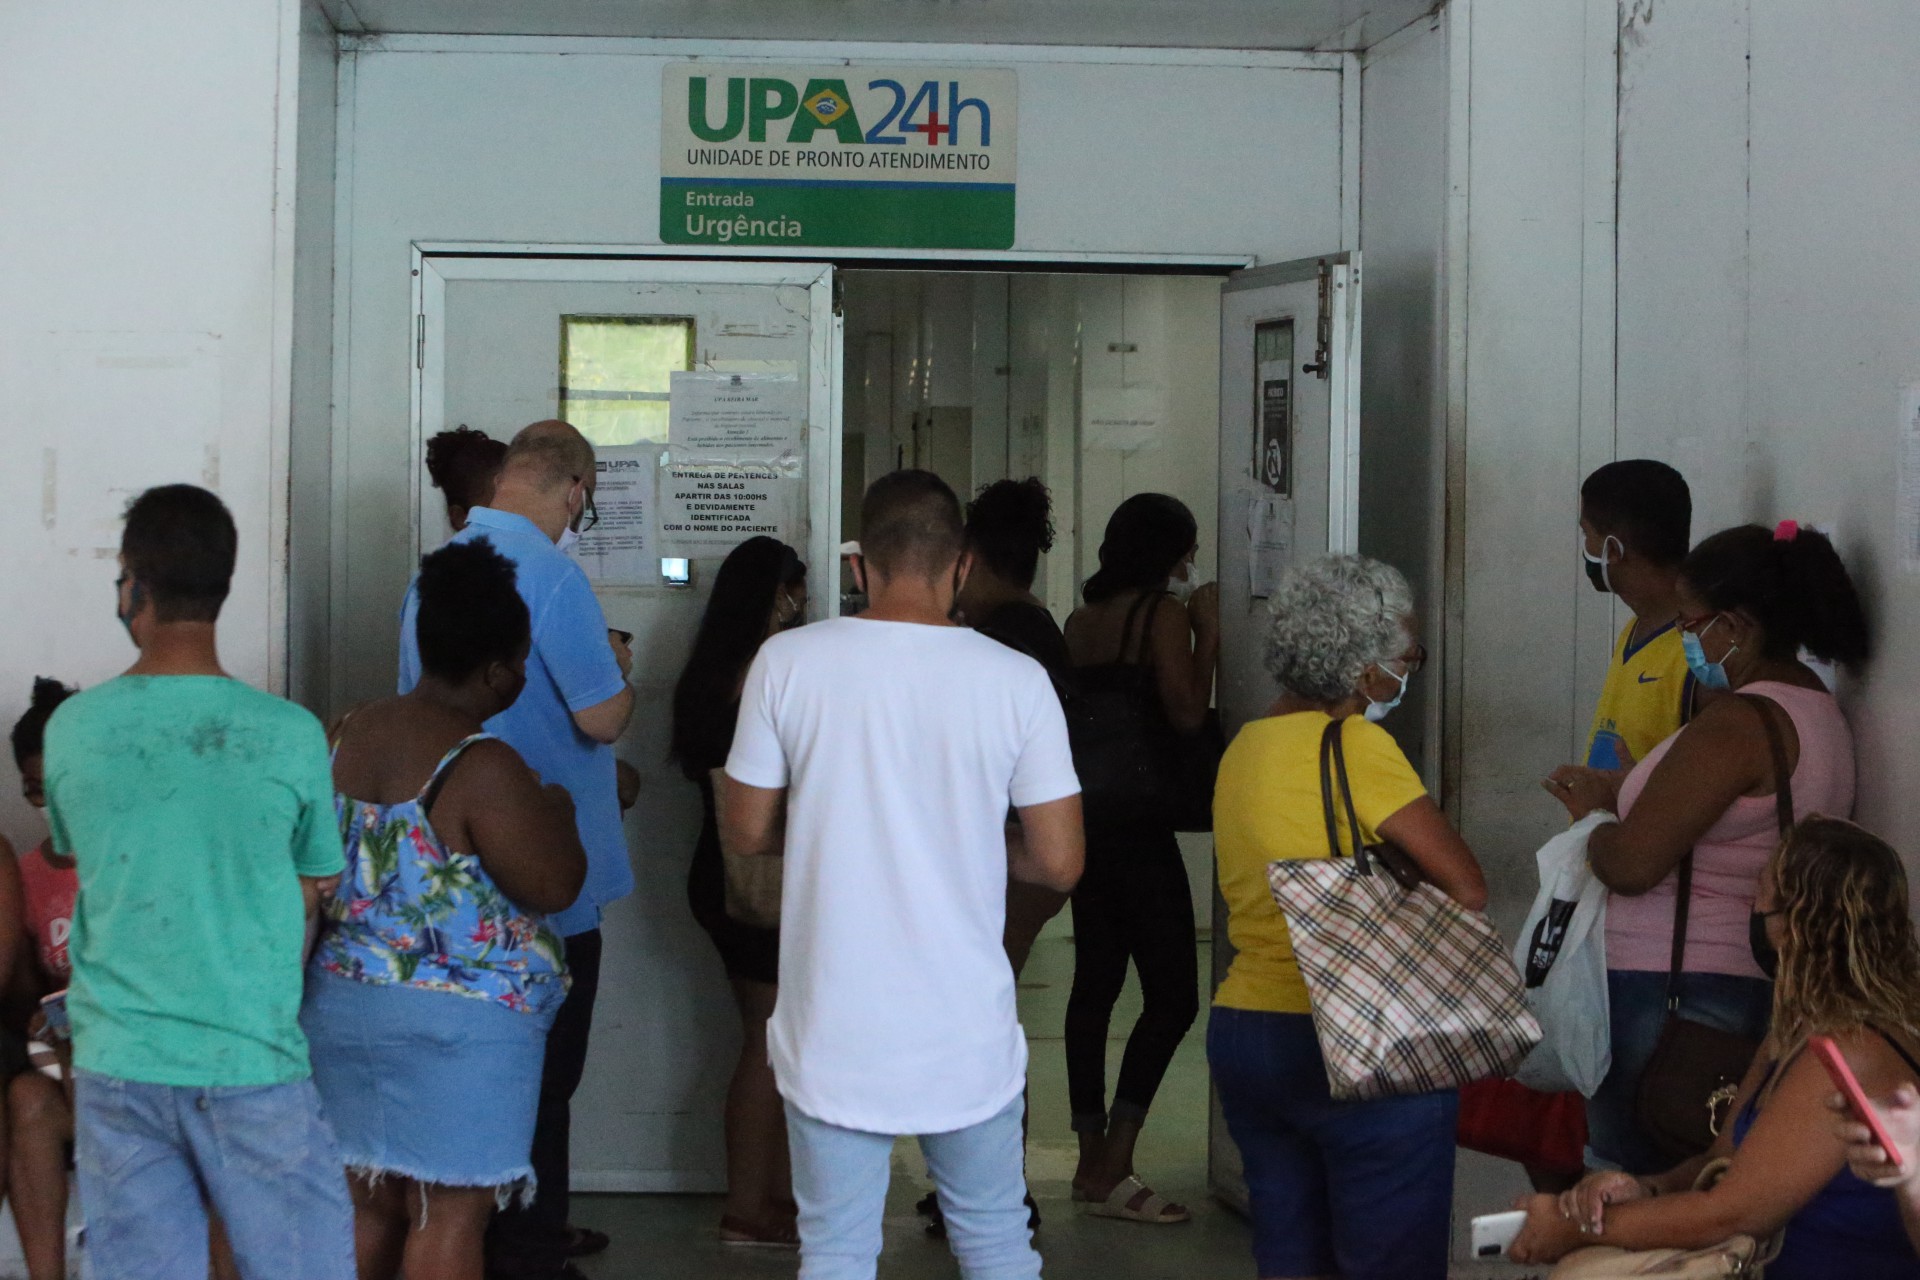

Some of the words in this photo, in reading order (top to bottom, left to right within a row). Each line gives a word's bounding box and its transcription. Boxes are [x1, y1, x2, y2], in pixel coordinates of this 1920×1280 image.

[687, 149, 763, 167] UNIDADE
[769, 150, 791, 168] DE
[796, 151, 865, 169] PRONTO
[869, 152, 990, 171] ATENDIMENTO
[686, 191, 755, 207] Entrada
[686, 214, 802, 242] Urgência
[672, 471, 712, 479] ENTREGA
[697, 482, 715, 490] NAS
[717, 482, 745, 490] SALAS
[734, 493, 768, 501] 10:00HS
[735, 525, 778, 533] PACIENTE
